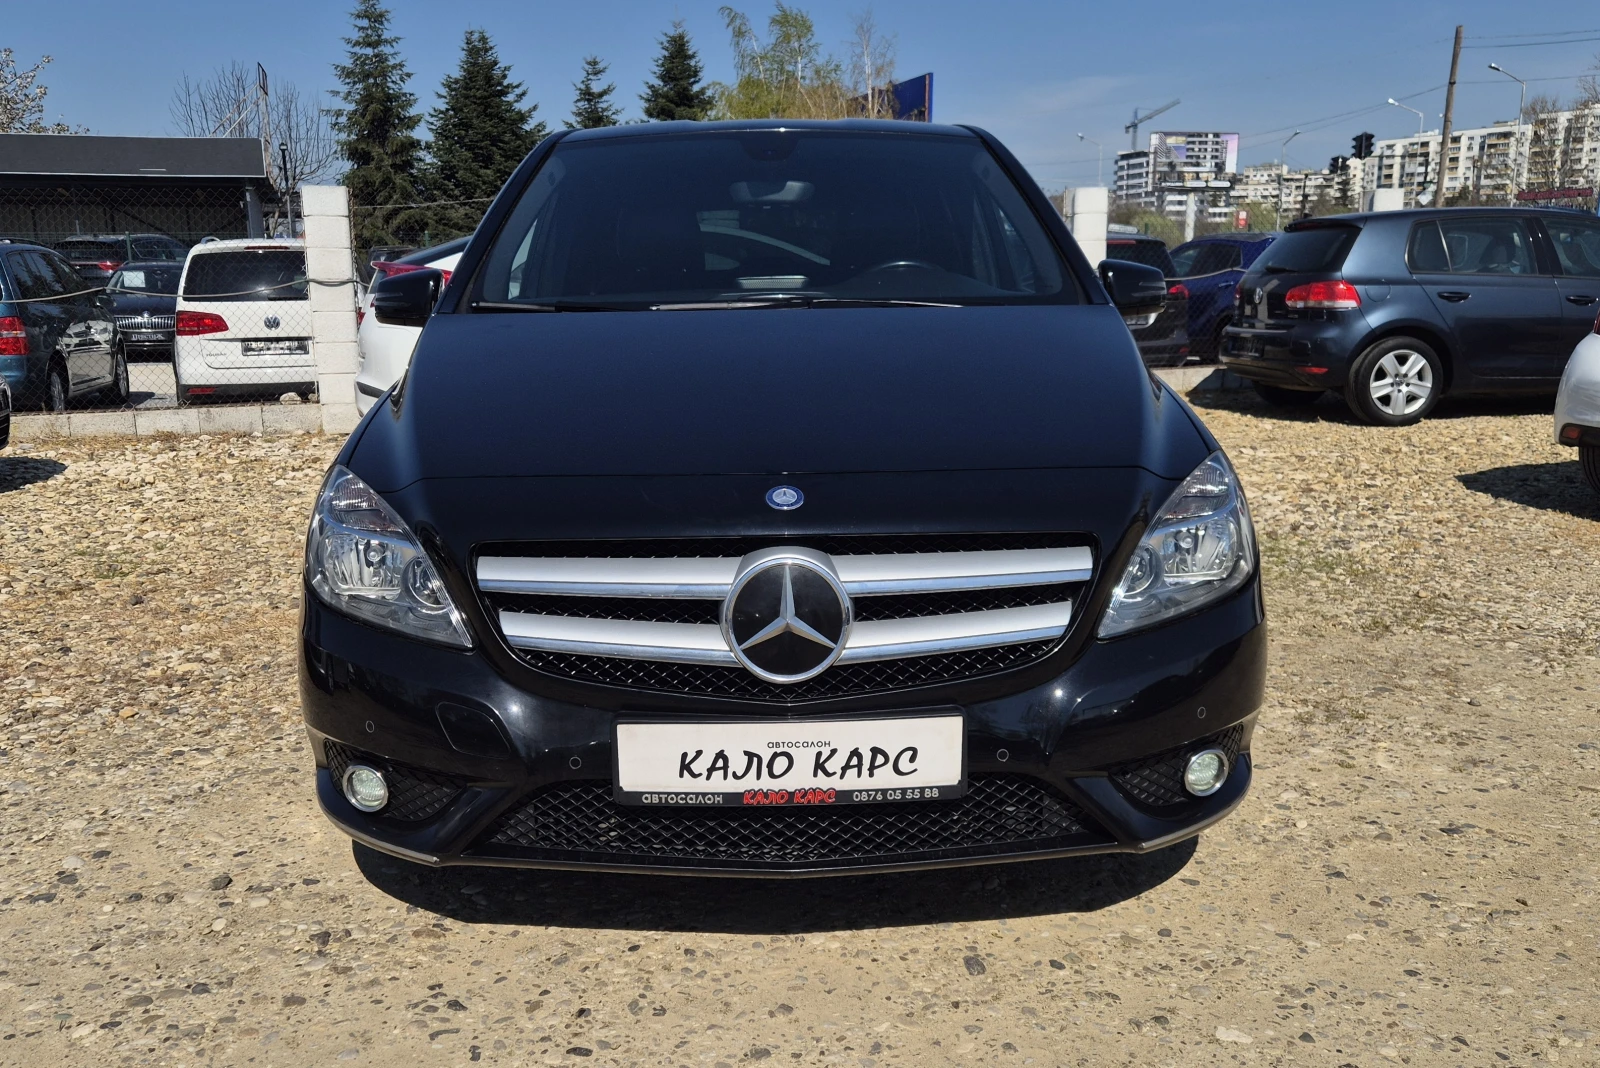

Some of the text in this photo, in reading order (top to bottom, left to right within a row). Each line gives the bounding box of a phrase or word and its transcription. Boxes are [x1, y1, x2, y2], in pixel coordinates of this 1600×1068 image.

[678, 747, 918, 781] КАЛО КАРС
[743, 790, 789, 805] КАЛО
[793, 788, 836, 804] КАРС
[852, 791, 883, 802] 0876
[886, 789, 902, 800] 05
[905, 788, 921, 799] 55
[924, 787, 940, 798] 88
